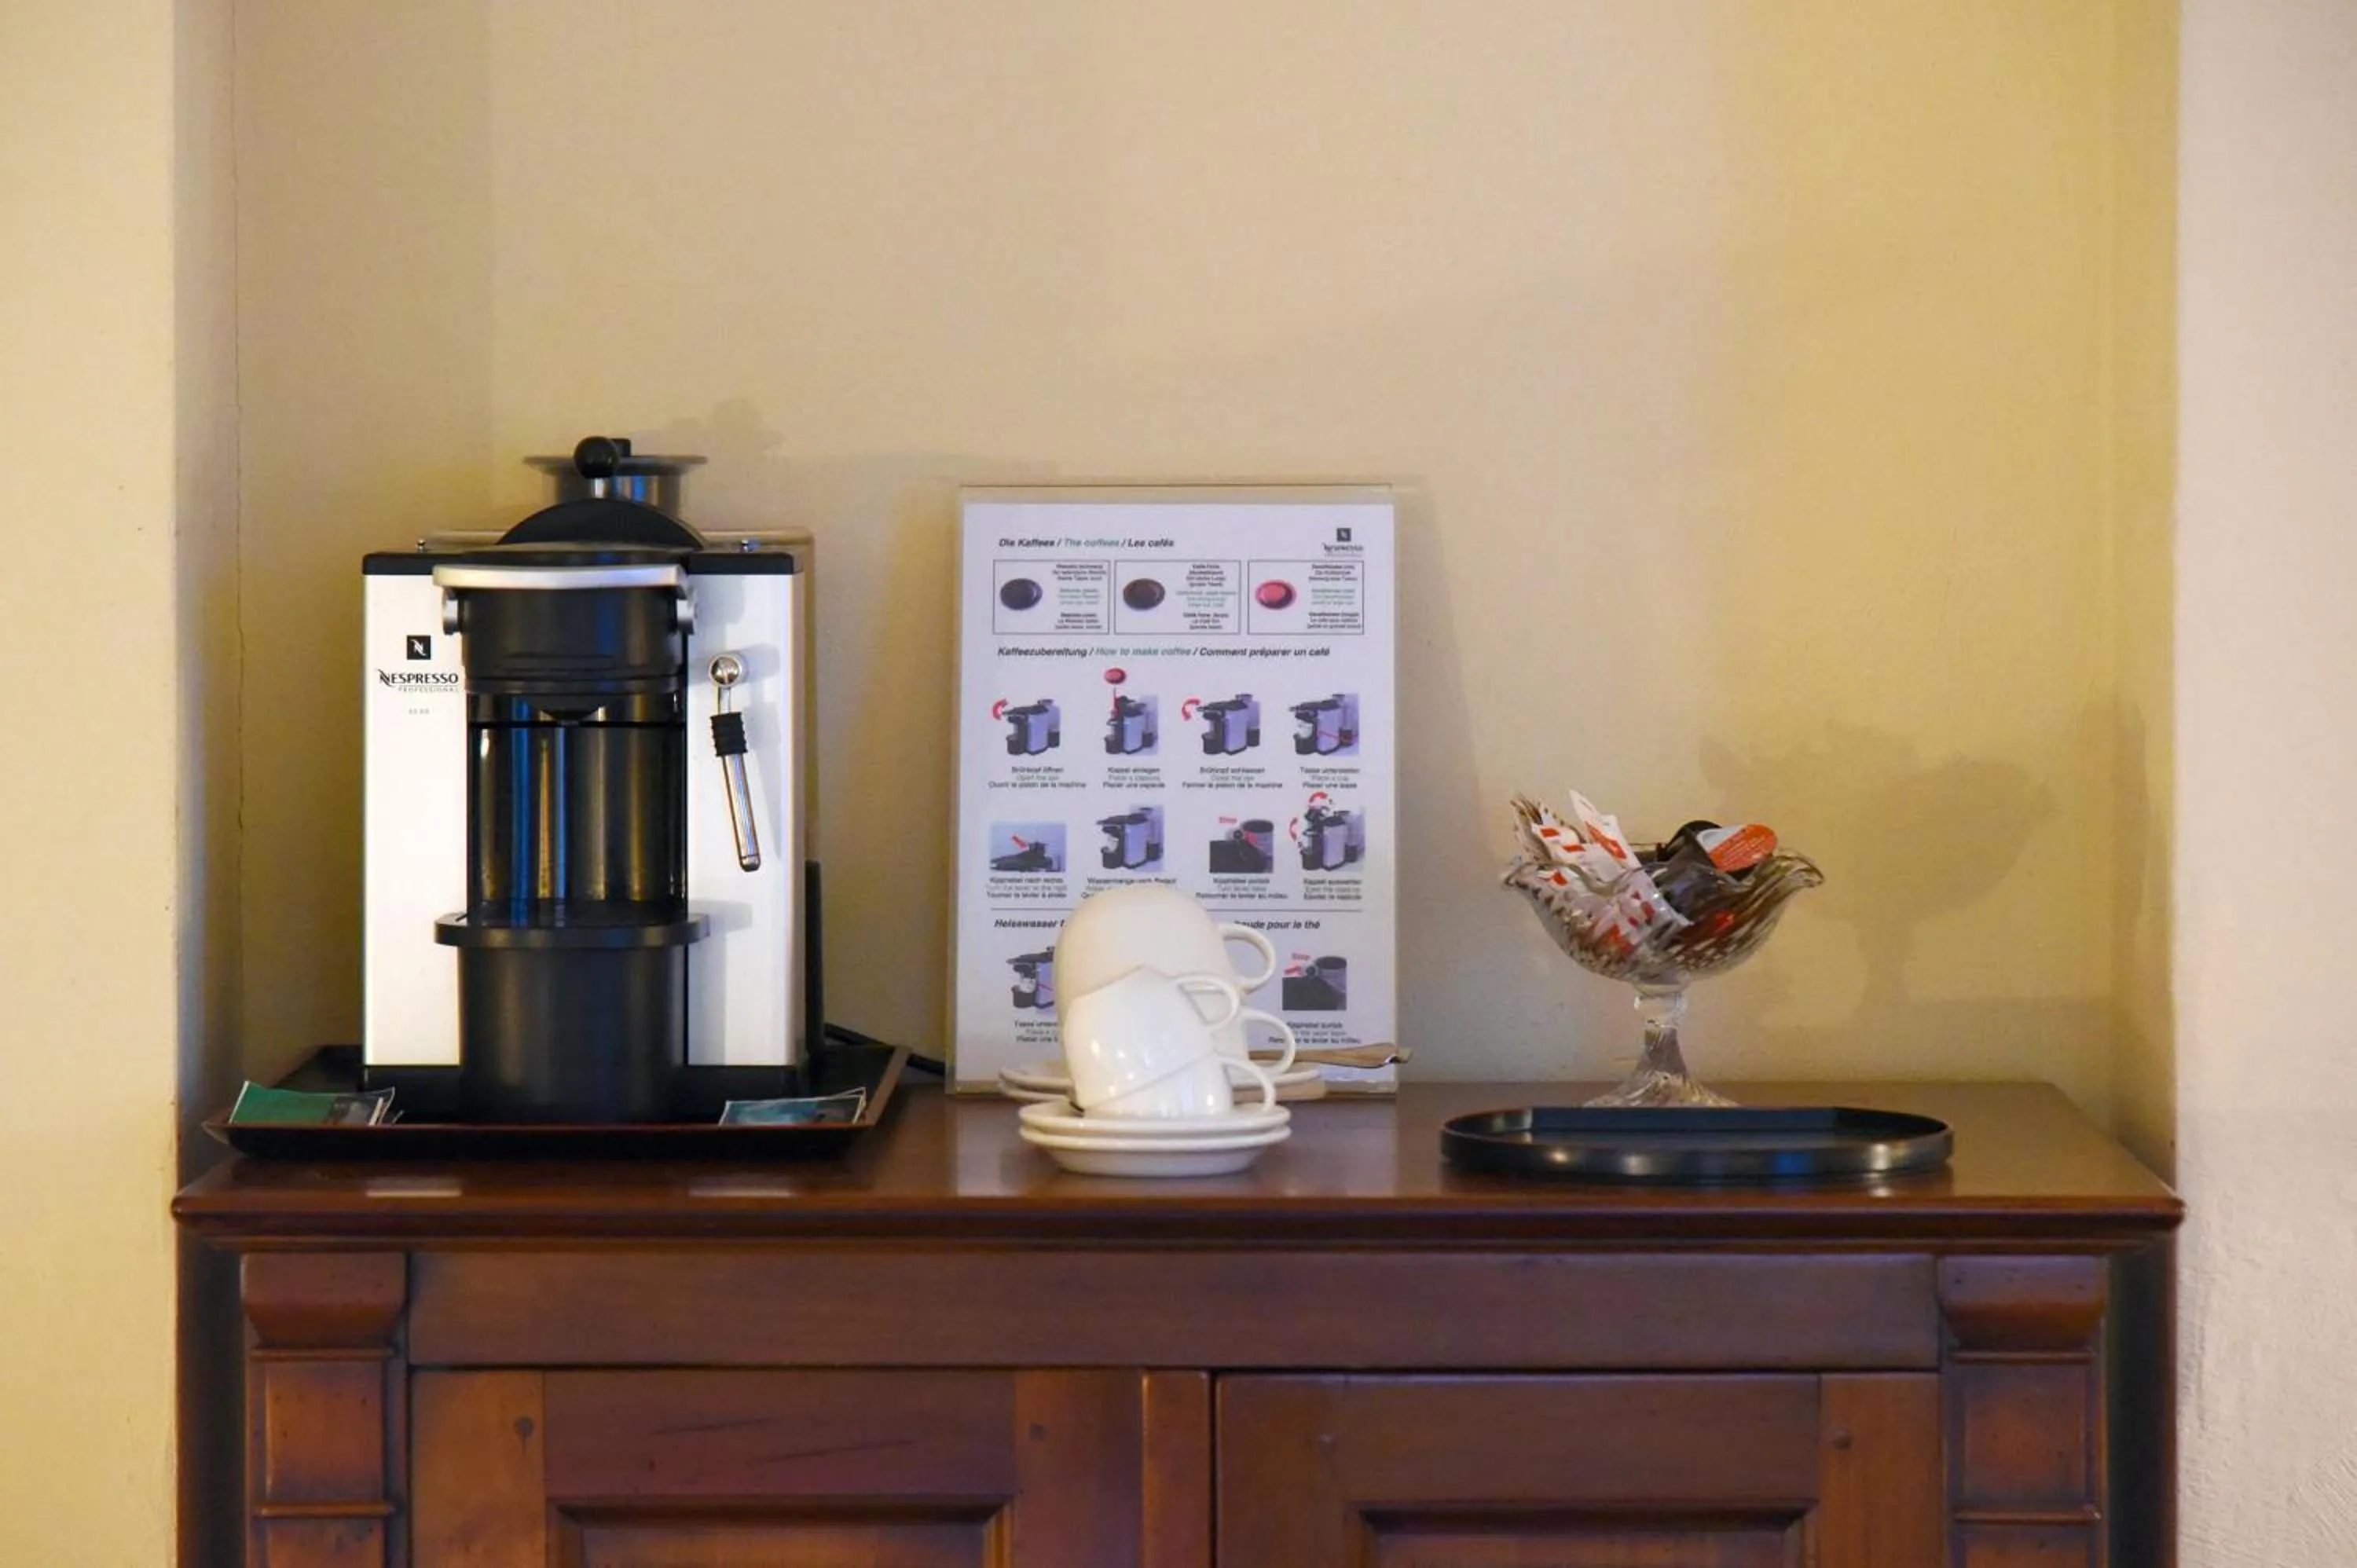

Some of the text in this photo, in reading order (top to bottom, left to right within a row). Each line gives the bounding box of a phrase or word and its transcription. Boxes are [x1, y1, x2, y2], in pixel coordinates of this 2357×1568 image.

[999, 538, 1014, 548] Die
[1017, 538, 1055, 548] Kaffees
[1065, 538, 1081, 548] The
[1083, 538, 1120, 548] coffees
[1127, 538, 1146, 548] Les
[997, 647, 1087, 658] Kaffeezubereitung
[1095, 647, 1116, 657] How
[1120, 647, 1130, 657] to
[1132, 647, 1158, 657] make
[1160, 647, 1191, 657] coffee
[1200, 647, 1247, 657] Comment
[1248, 647, 1292, 658] préparer
[1293, 647, 1307, 657] un
[1308, 647, 1330, 657] café
[378, 669, 459, 687] NESPRESSO
[1266, 921, 1290, 931] pour
[1292, 920, 1303, 929] le
[1303, 920, 1321, 929] thé
